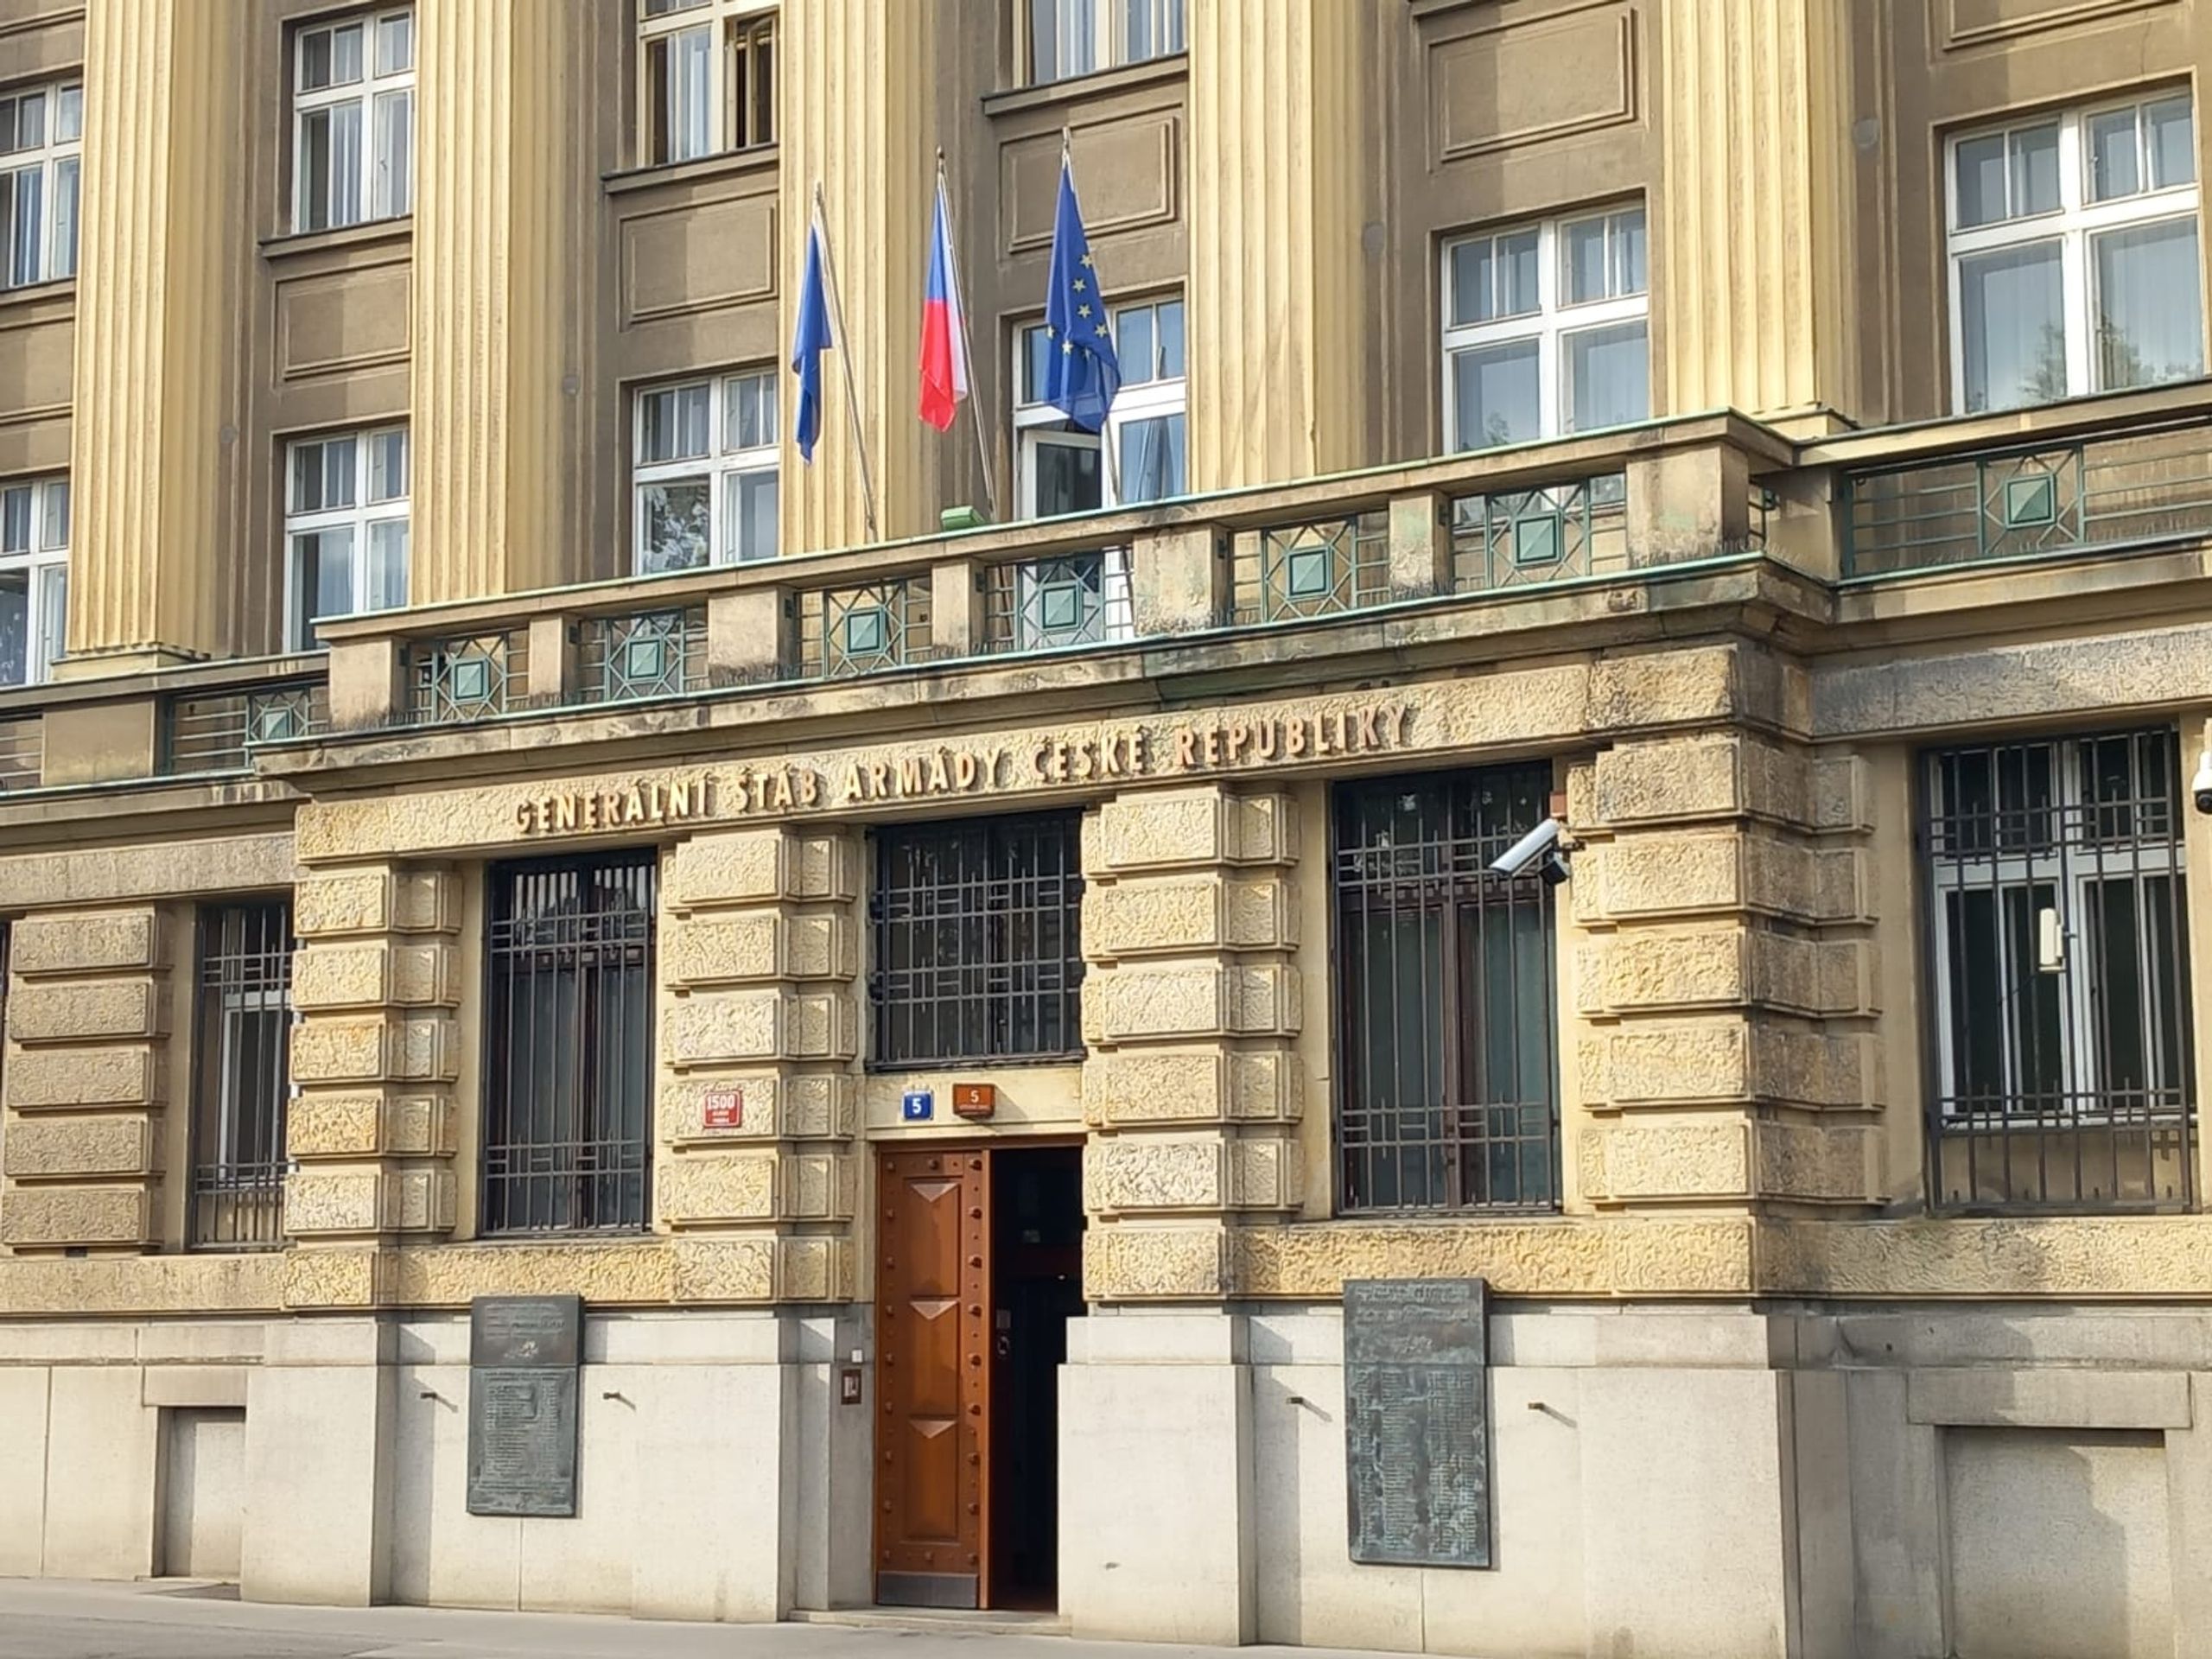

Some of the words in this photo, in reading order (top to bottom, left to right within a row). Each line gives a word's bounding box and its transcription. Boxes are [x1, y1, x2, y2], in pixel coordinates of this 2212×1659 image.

[515, 772, 710, 833] GENERÁLNÍ
[731, 763, 817, 812] ŠTÁB
[844, 745, 1002, 798] ARMÁDY
[1029, 725, 1143, 781] ČESKÉ
[1173, 703, 1407, 766] REPUBLIKY
[707, 1094, 735, 1109] 1500
[970, 1090, 980, 1103] 5
[912, 1097, 922, 1115] 5
